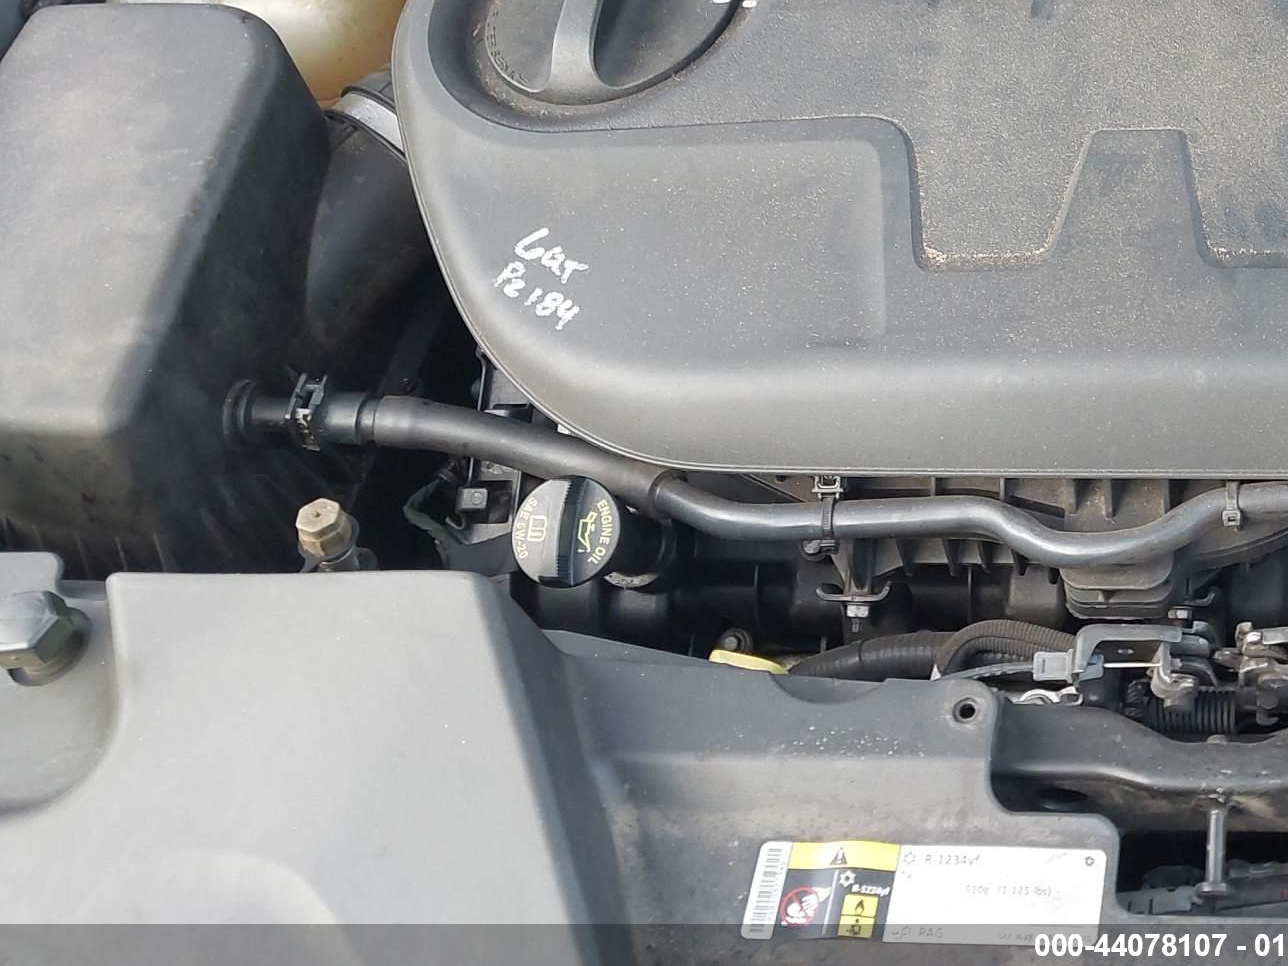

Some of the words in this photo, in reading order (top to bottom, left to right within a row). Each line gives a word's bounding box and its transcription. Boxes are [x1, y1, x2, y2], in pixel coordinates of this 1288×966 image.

[520, 497, 538, 522] SAE
[596, 499, 613, 545] ENGINE
[515, 523, 529, 560] 5W-20
[587, 546, 606, 565] OIL
[918, 927, 944, 940] PAG
